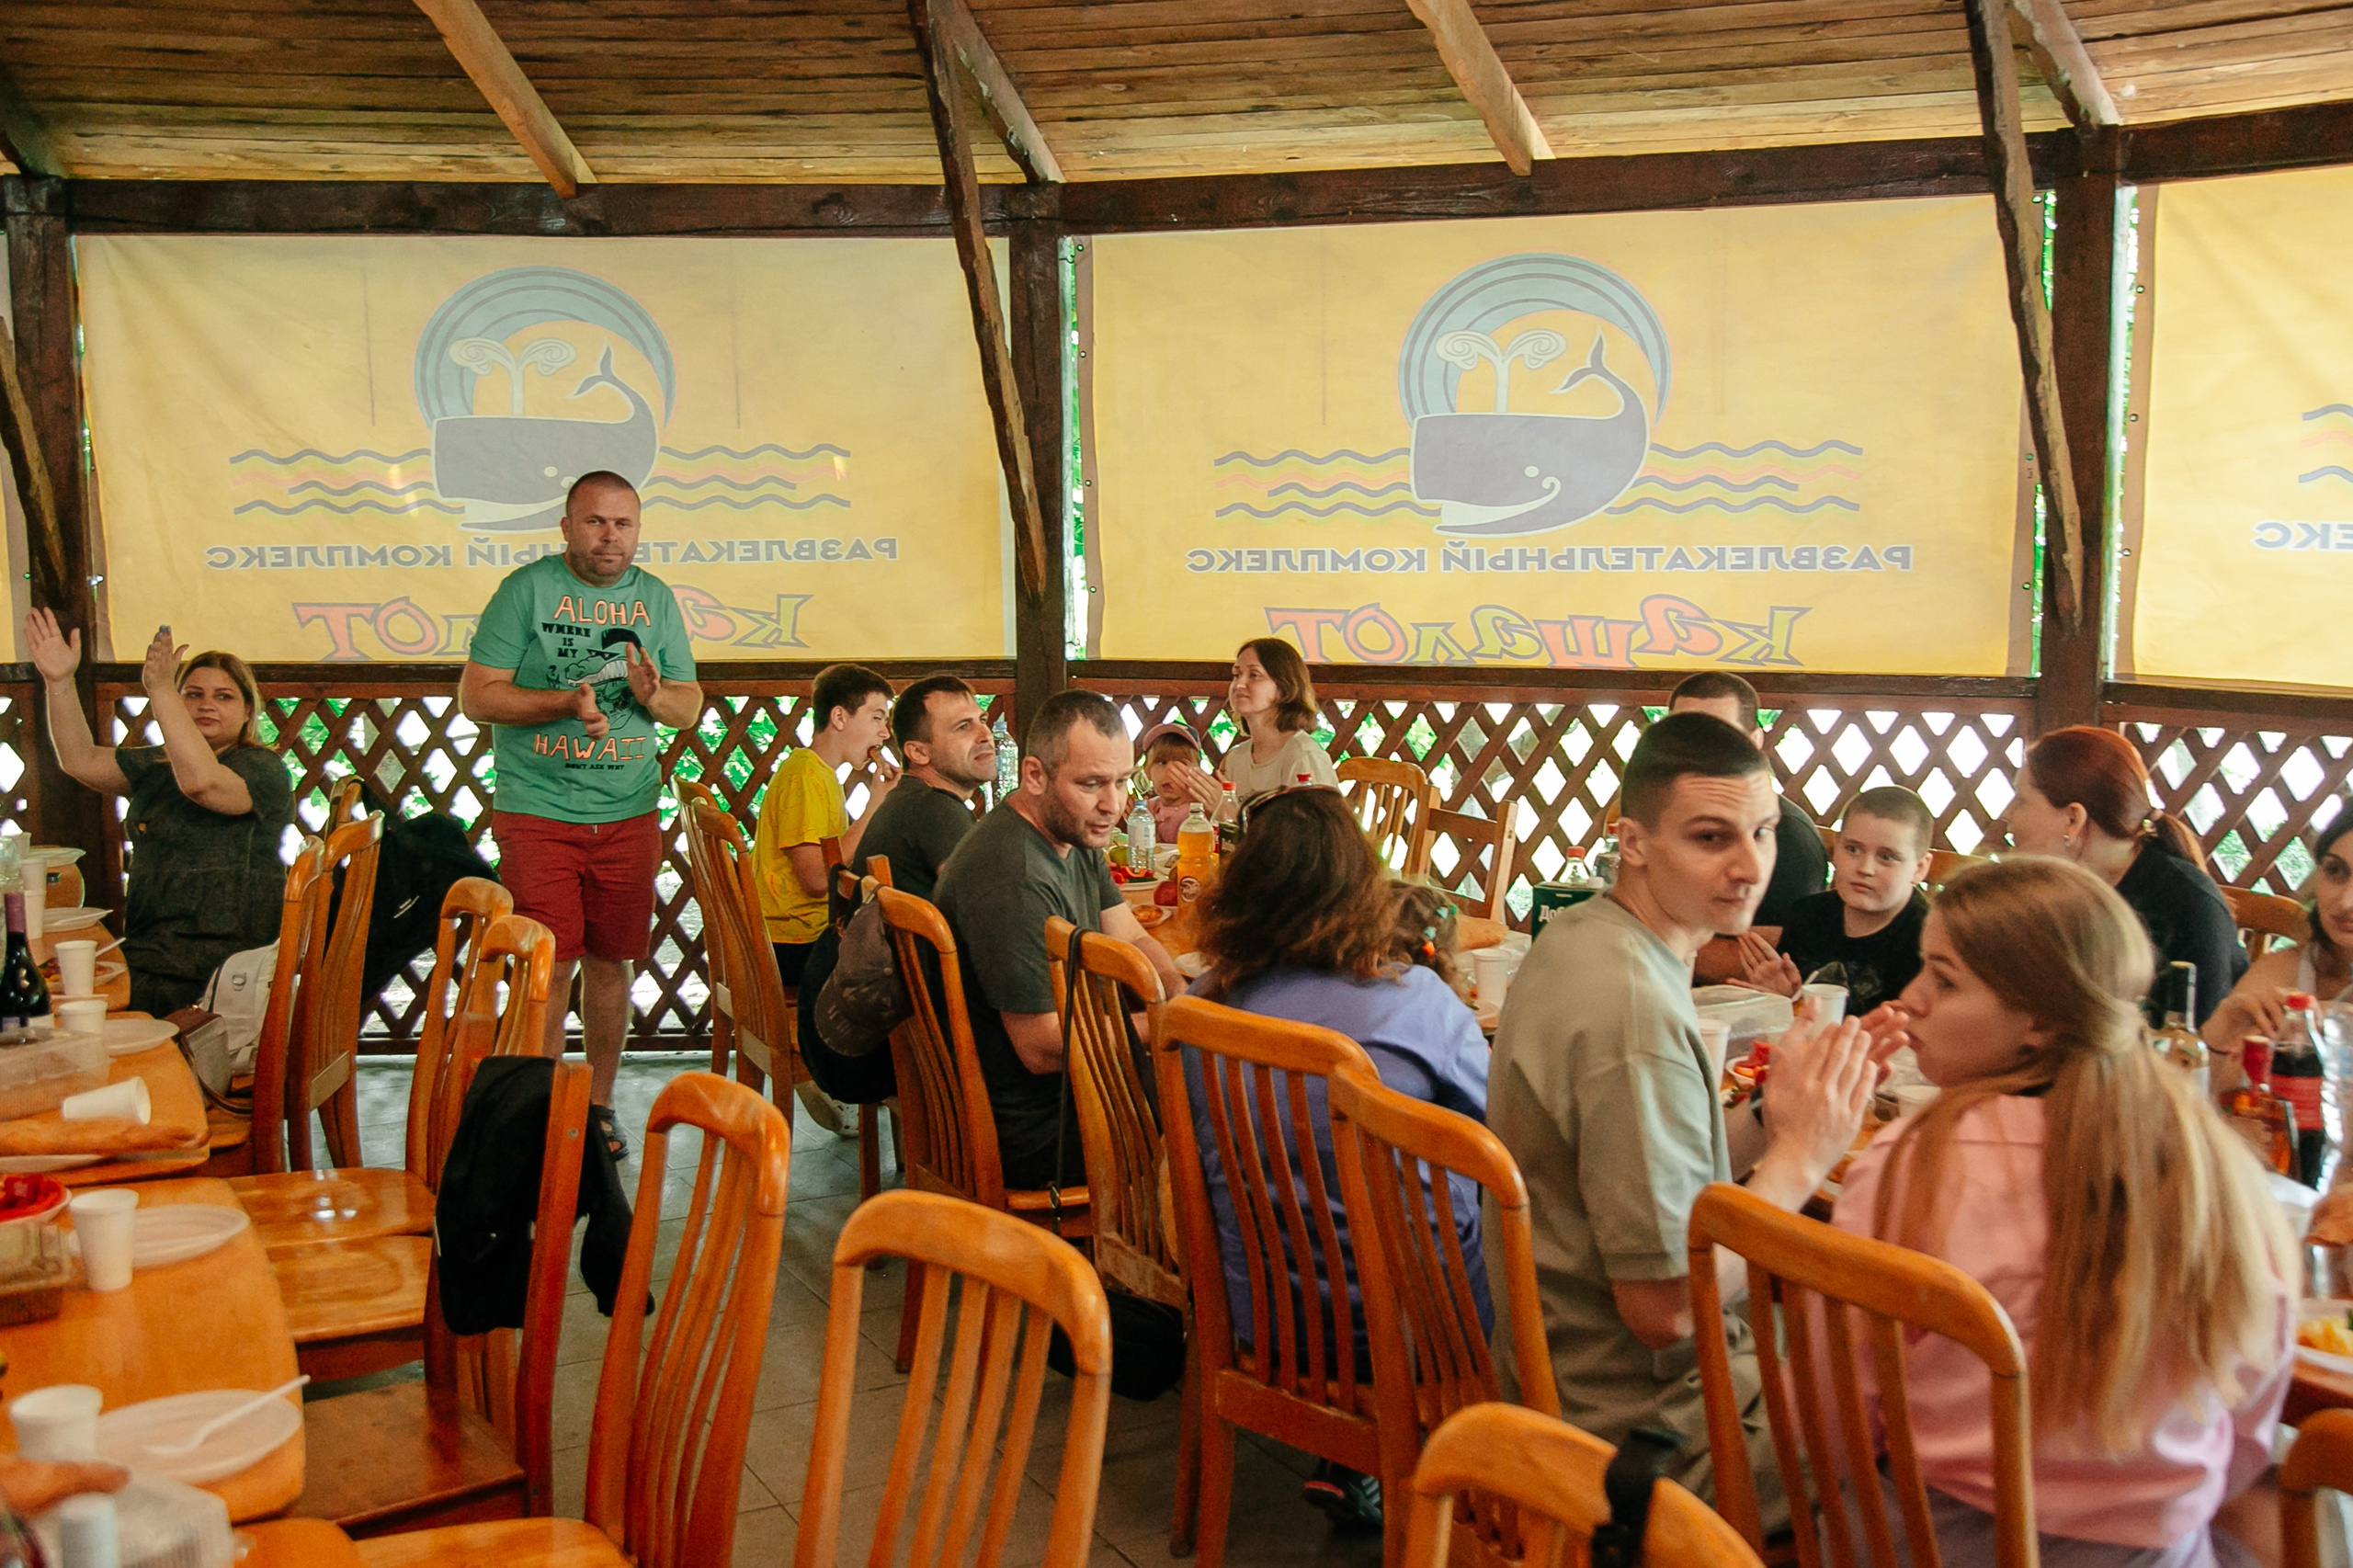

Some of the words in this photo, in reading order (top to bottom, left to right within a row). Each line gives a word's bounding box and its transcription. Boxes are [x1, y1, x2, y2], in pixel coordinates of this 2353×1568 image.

[554, 595, 651, 628] ALOHA
[541, 621, 592, 639] WHERE
[563, 637, 574, 647] IS
[557, 647, 578, 659] MY
[534, 733, 646, 762] HAWAII
